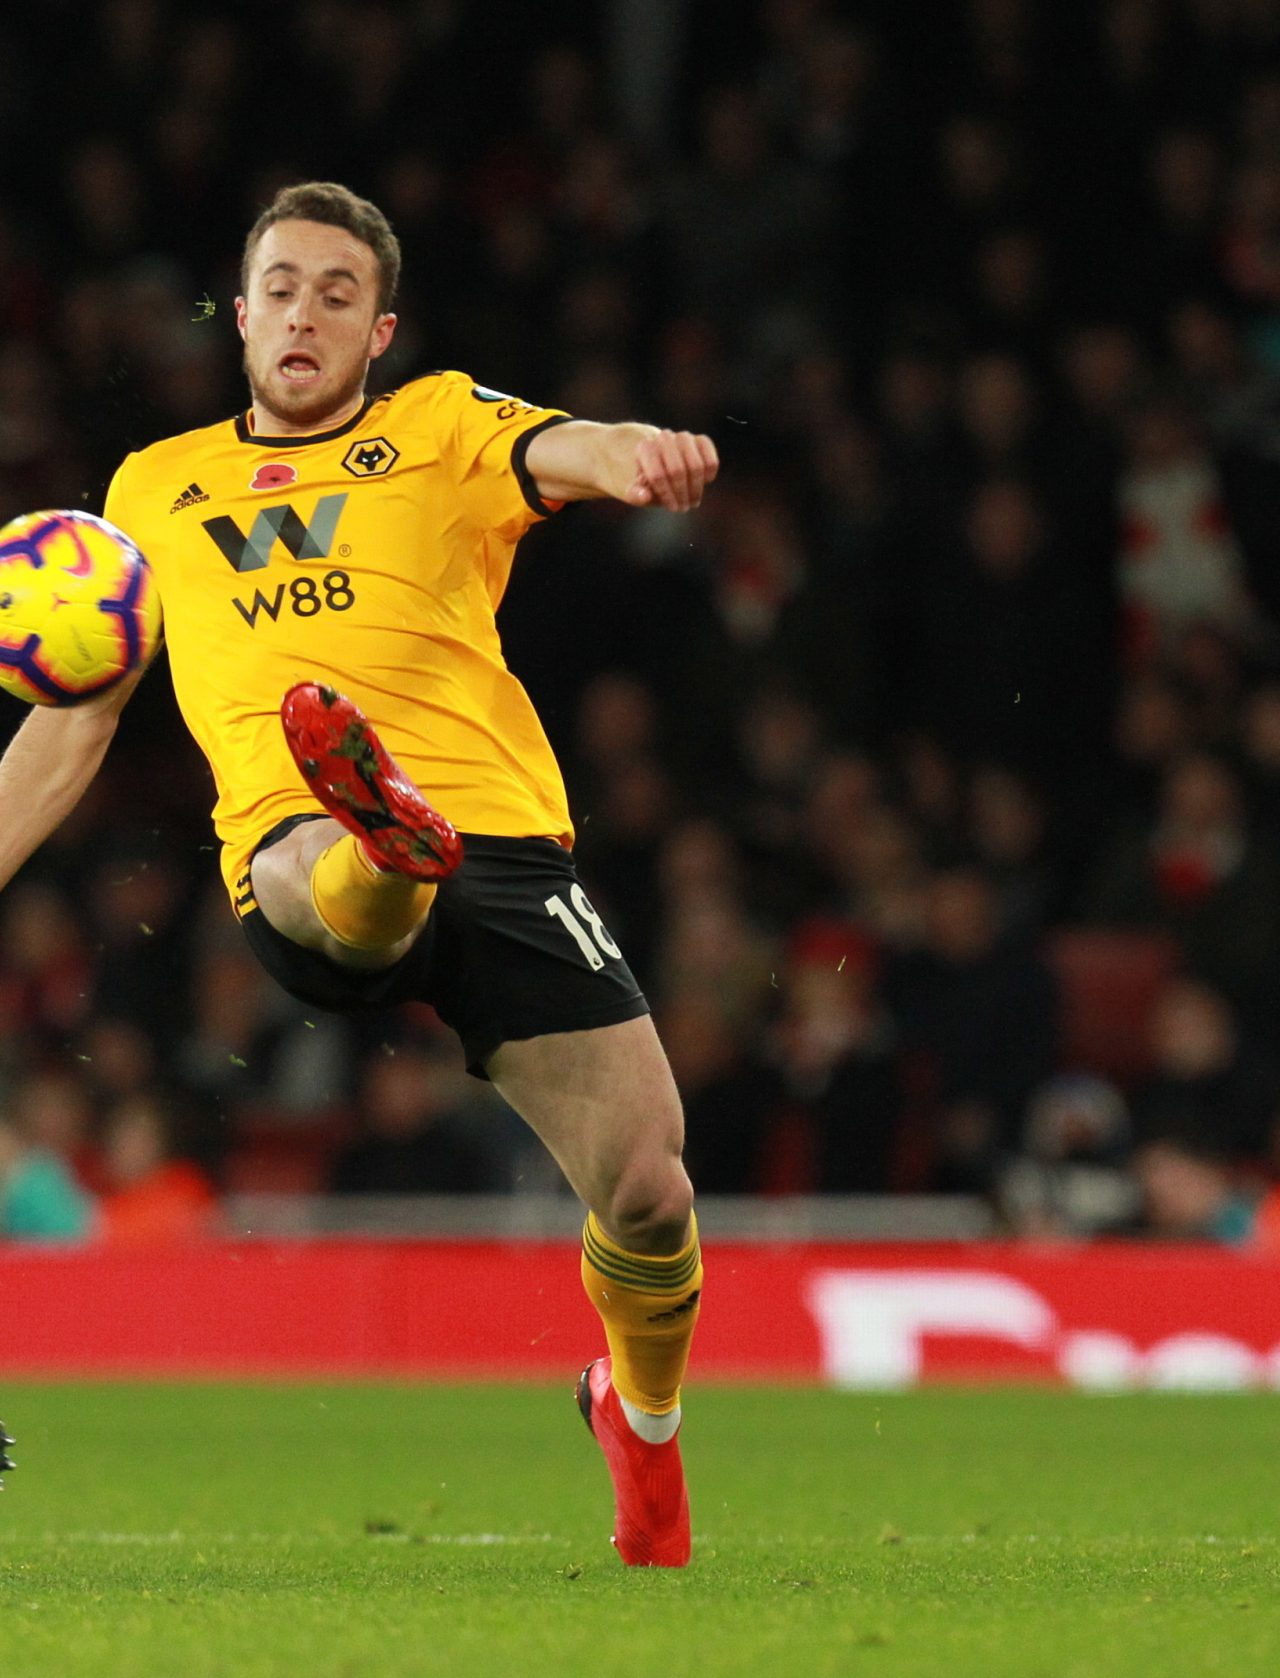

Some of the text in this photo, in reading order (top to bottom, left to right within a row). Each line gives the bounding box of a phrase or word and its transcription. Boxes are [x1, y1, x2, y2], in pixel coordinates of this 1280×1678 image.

[170, 494, 210, 514] adidas
[231, 570, 355, 629] W88
[544, 882, 622, 972] 18
